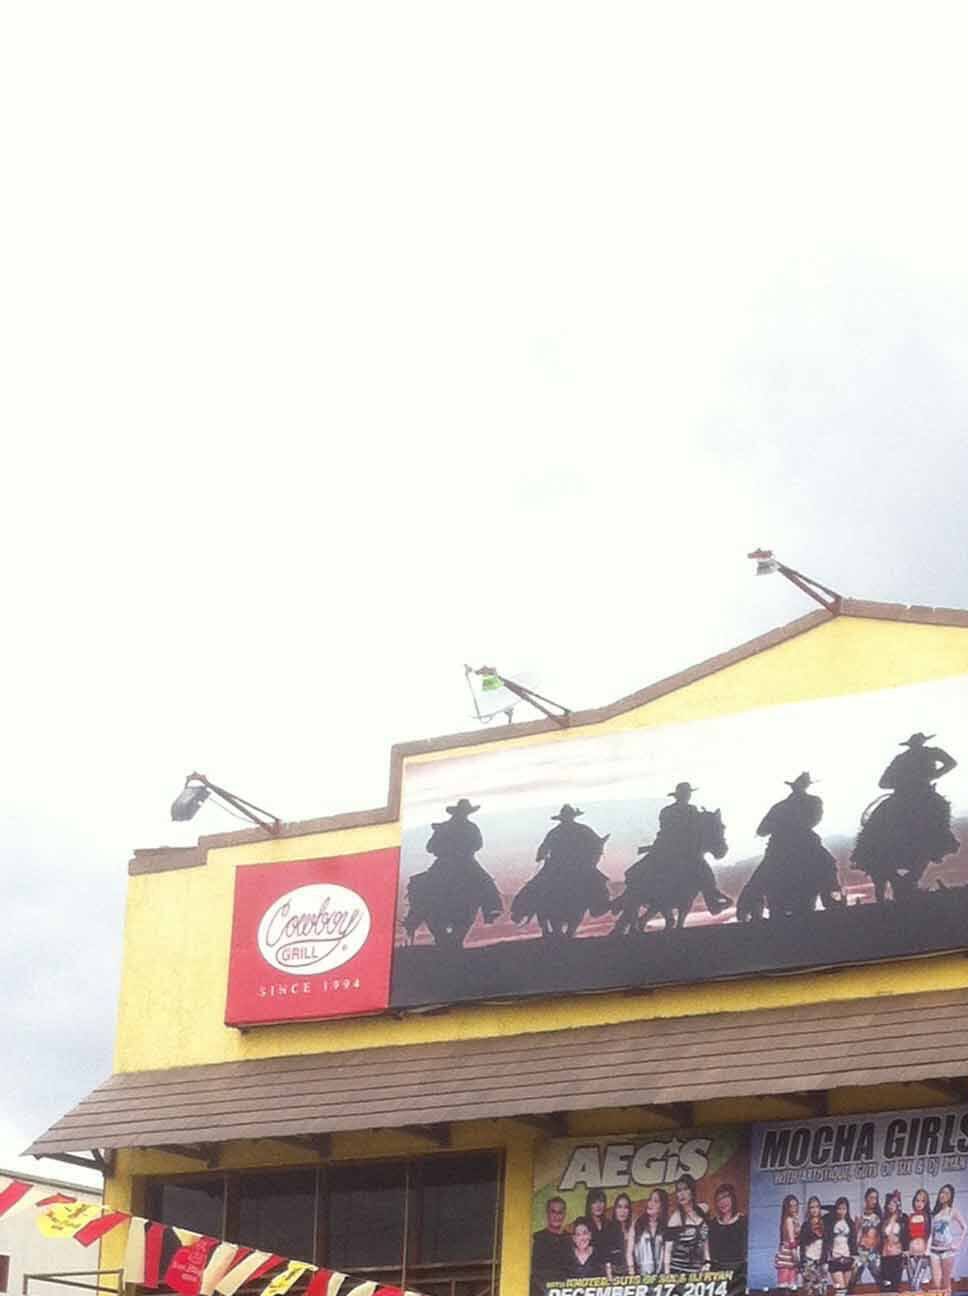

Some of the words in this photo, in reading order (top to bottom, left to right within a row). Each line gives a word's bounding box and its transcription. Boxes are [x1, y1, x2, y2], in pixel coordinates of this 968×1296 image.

[265, 896, 363, 948] Cowboy
[281, 948, 319, 962] GRILL
[258, 982, 312, 997] SINCE
[323, 978, 361, 991] 1994
[759, 1120, 877, 1171] MOCHA
